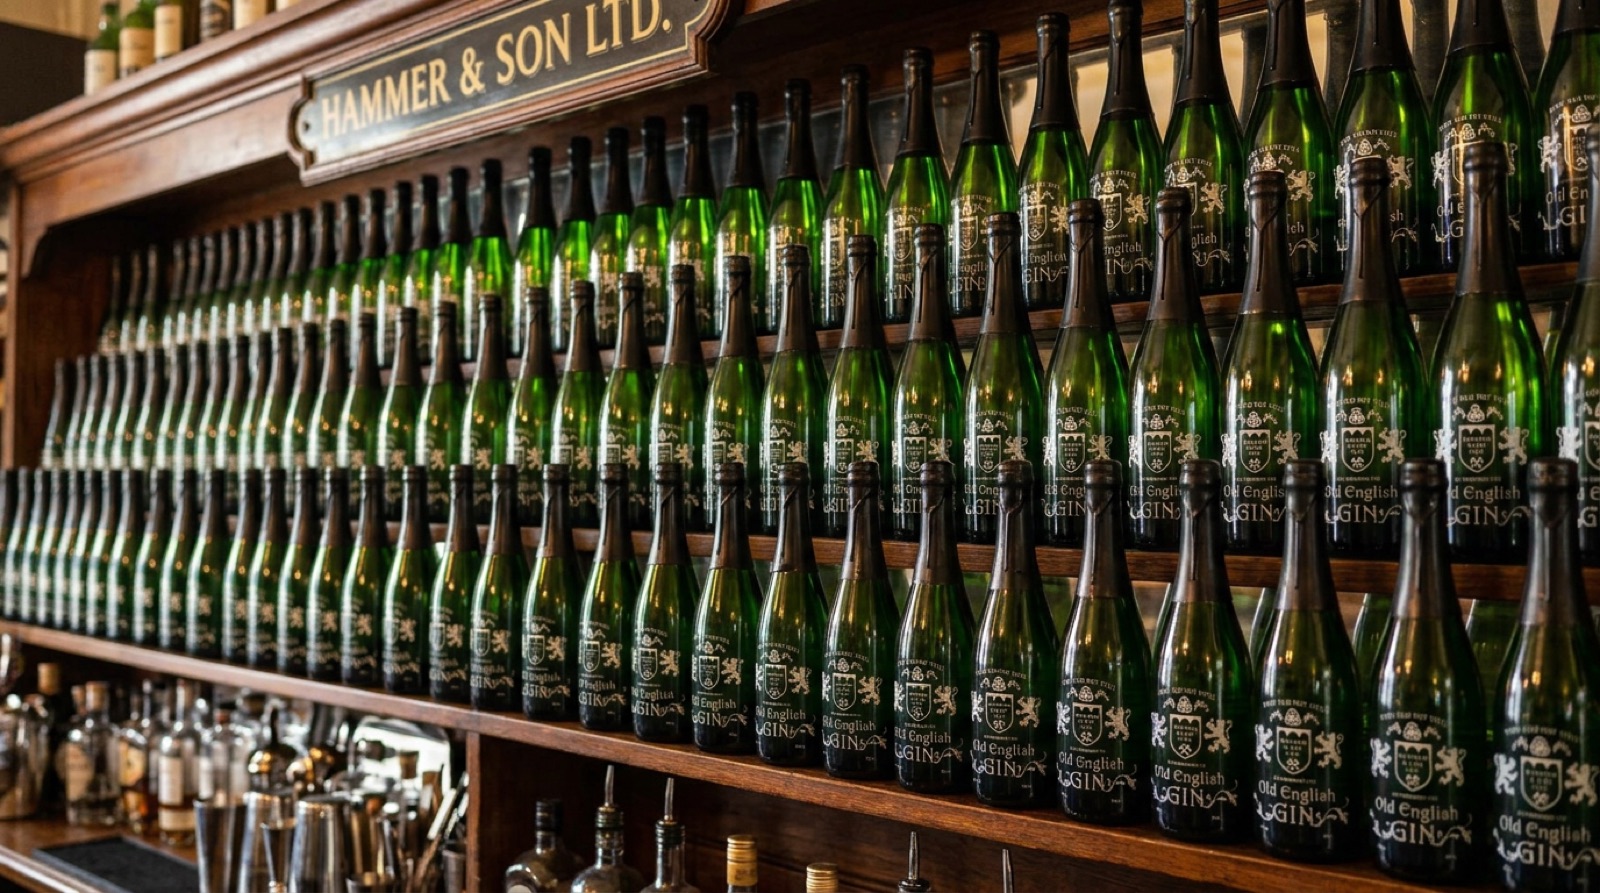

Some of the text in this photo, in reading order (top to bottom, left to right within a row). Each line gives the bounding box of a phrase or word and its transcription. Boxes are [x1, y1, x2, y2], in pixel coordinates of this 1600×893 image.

[321, 0, 672, 141] HAMMER & SON LTD.
[1559, 204, 1587, 228] GI
[1146, 484, 1179, 500] Engli
[1243, 484, 1285, 501] Englis
[1344, 485, 1398, 502] English
[1463, 485, 1521, 504] English
[1142, 502, 1175, 519] GIN
[1236, 502, 1273, 523] GIN
[1337, 503, 1378, 524] GIN
[1454, 505, 1499, 526] GIN
[762, 720, 789, 739] GIN
[908, 729, 952, 746] English
[829, 733, 860, 751] GIN
[902, 742, 934, 763] GIN
[988, 742, 1035, 760] English
[983, 757, 1017, 778] GIN
[1075, 754, 1125, 774] English
[1069, 770, 1104, 792] GIN
[1174, 769, 1226, 788] English
[1167, 786, 1205, 808] GIN
[1258, 779, 1277, 797] Old
[1280, 784, 1336, 806] English
[1272, 801, 1314, 826] GIN
[1374, 796, 1396, 815] Old
[1398, 801, 1459, 824] English
[1389, 819, 1436, 845] GIN
[1498, 813, 1522, 836] Old
[1525, 820, 1592, 845] English
[1517, 839, 1566, 867] GIN
